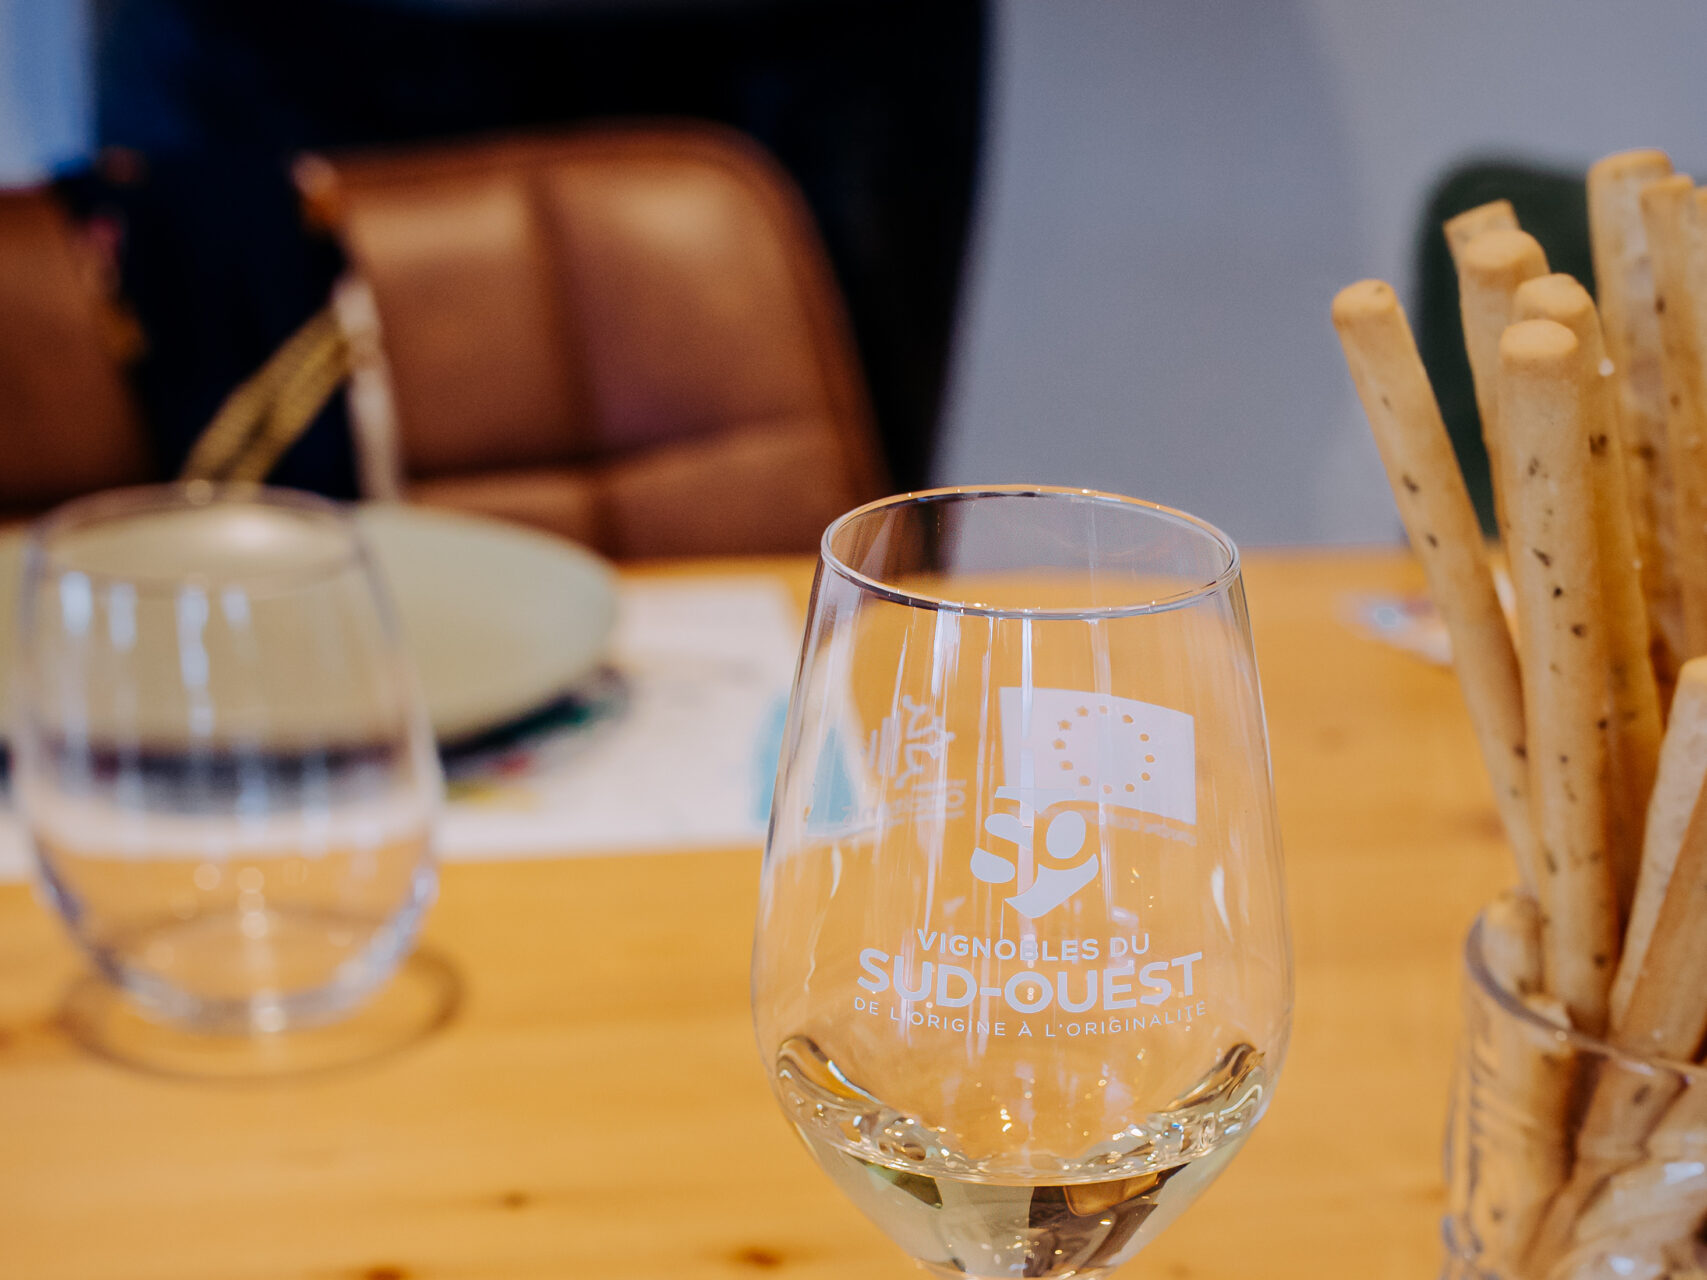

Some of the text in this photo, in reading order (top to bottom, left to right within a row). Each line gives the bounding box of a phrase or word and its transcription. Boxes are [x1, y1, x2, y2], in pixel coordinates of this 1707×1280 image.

[916, 928, 1150, 962] VIGNOBLES DU
[856, 947, 1203, 1014] SUD-OUEST
[853, 996, 880, 1016] DE
[889, 1006, 1007, 1037] LORIGINE
[1017, 1020, 1034, 1038] À
